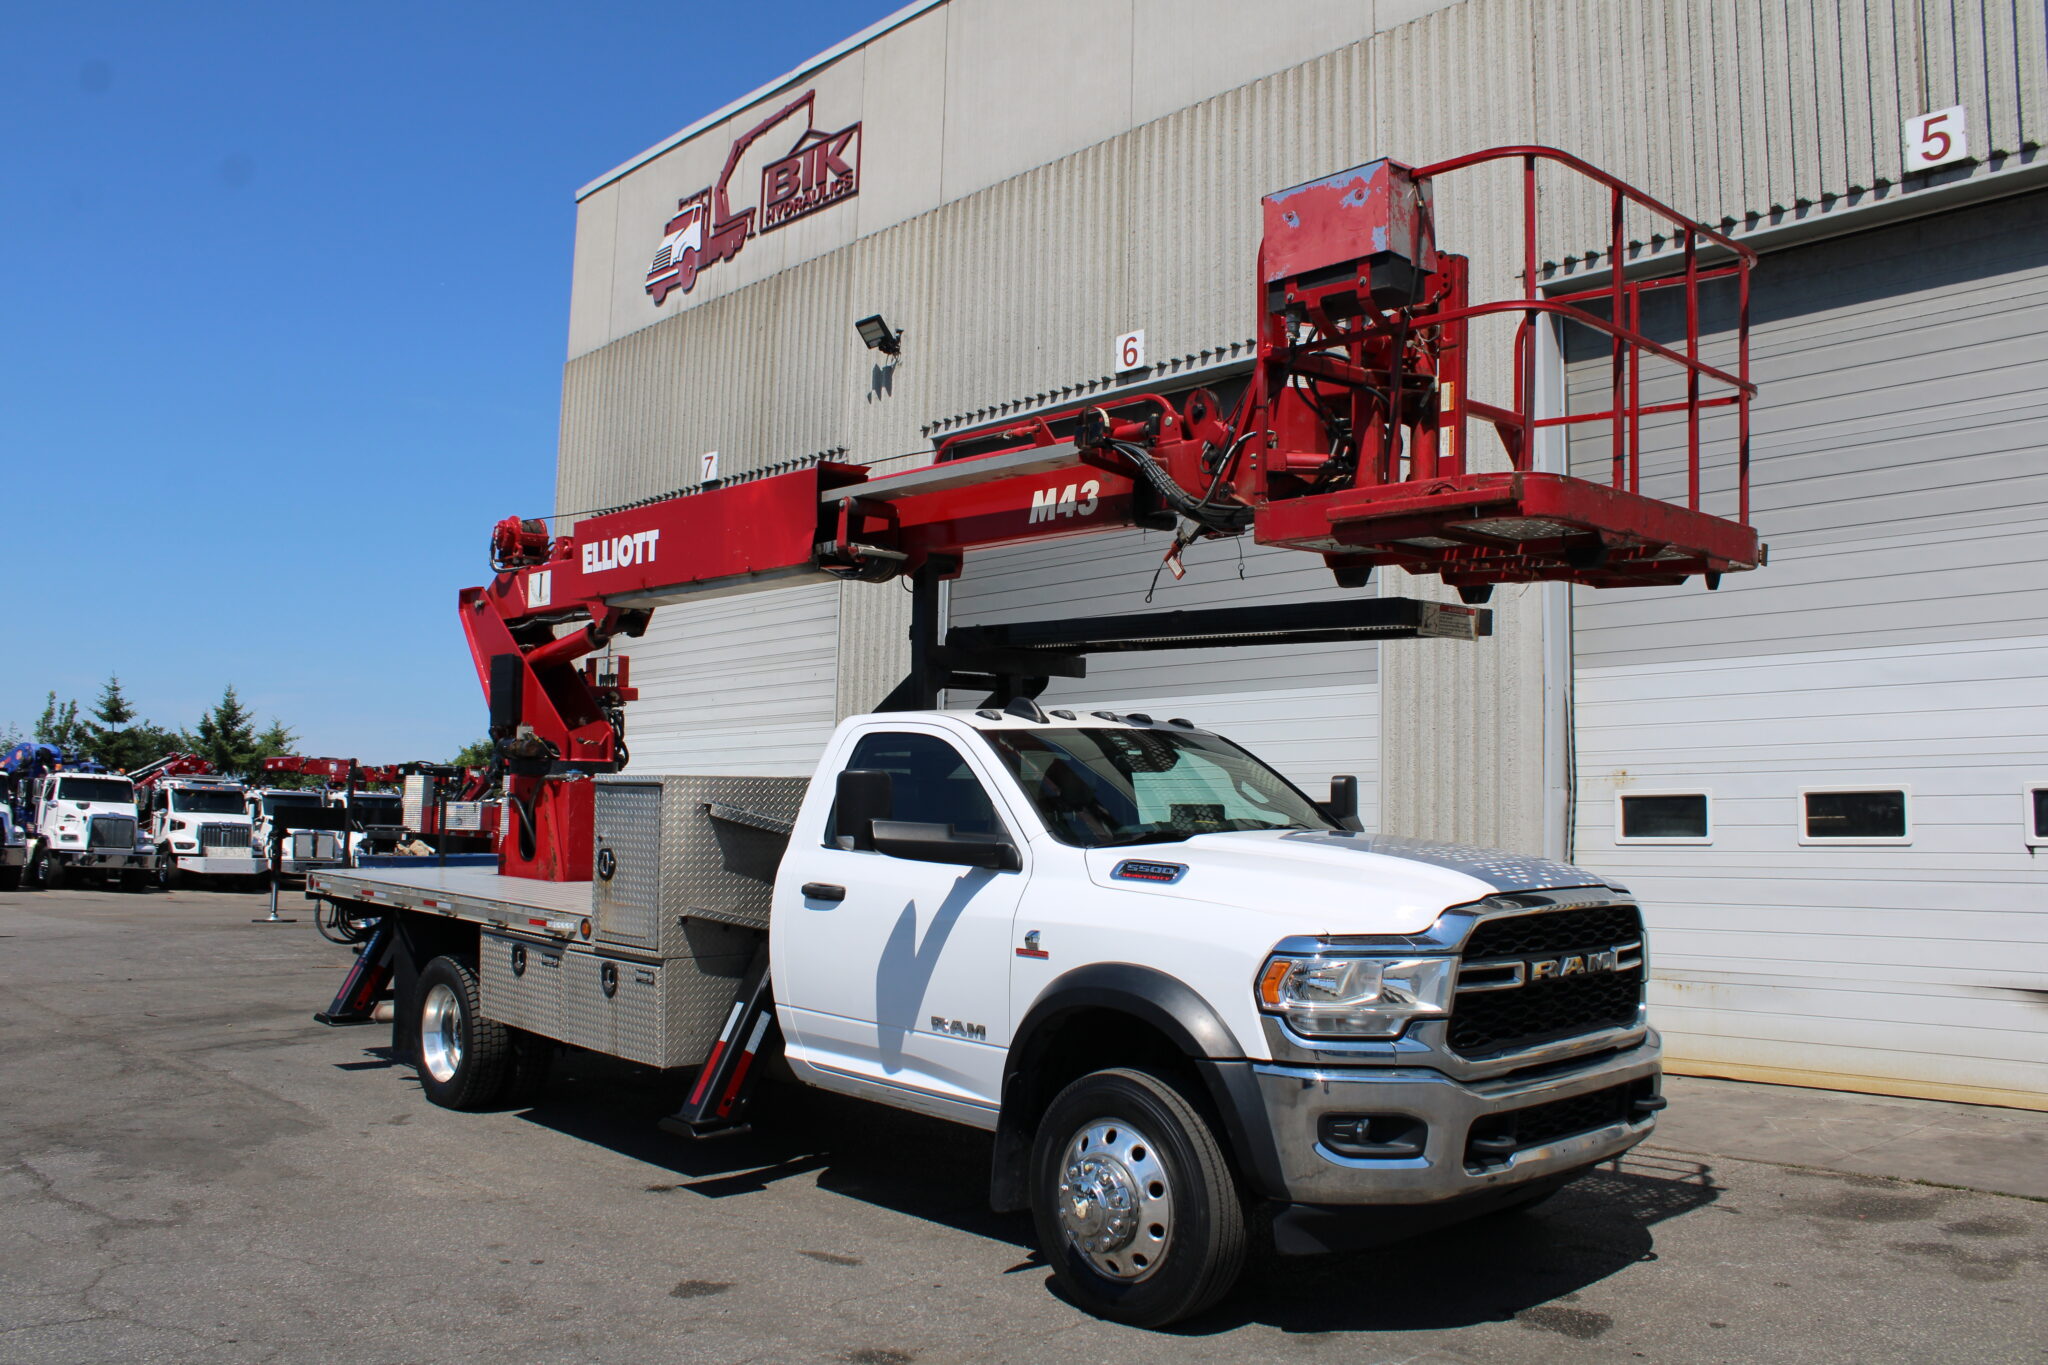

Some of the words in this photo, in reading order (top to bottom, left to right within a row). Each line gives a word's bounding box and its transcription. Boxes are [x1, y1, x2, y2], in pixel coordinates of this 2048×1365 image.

[1921, 114, 1951, 161] 5
[767, 132, 853, 207] BIK
[765, 172, 854, 225] HYDRAULICS
[1123, 336, 1138, 367] 6
[704, 455, 714, 479] 7
[1028, 480, 1100, 524] M43
[582, 529, 660, 574] ELLIOTT
[1127, 864, 1175, 874] 5500
[1531, 951, 1612, 980] RAM
[930, 1015, 987, 1041] RAM
